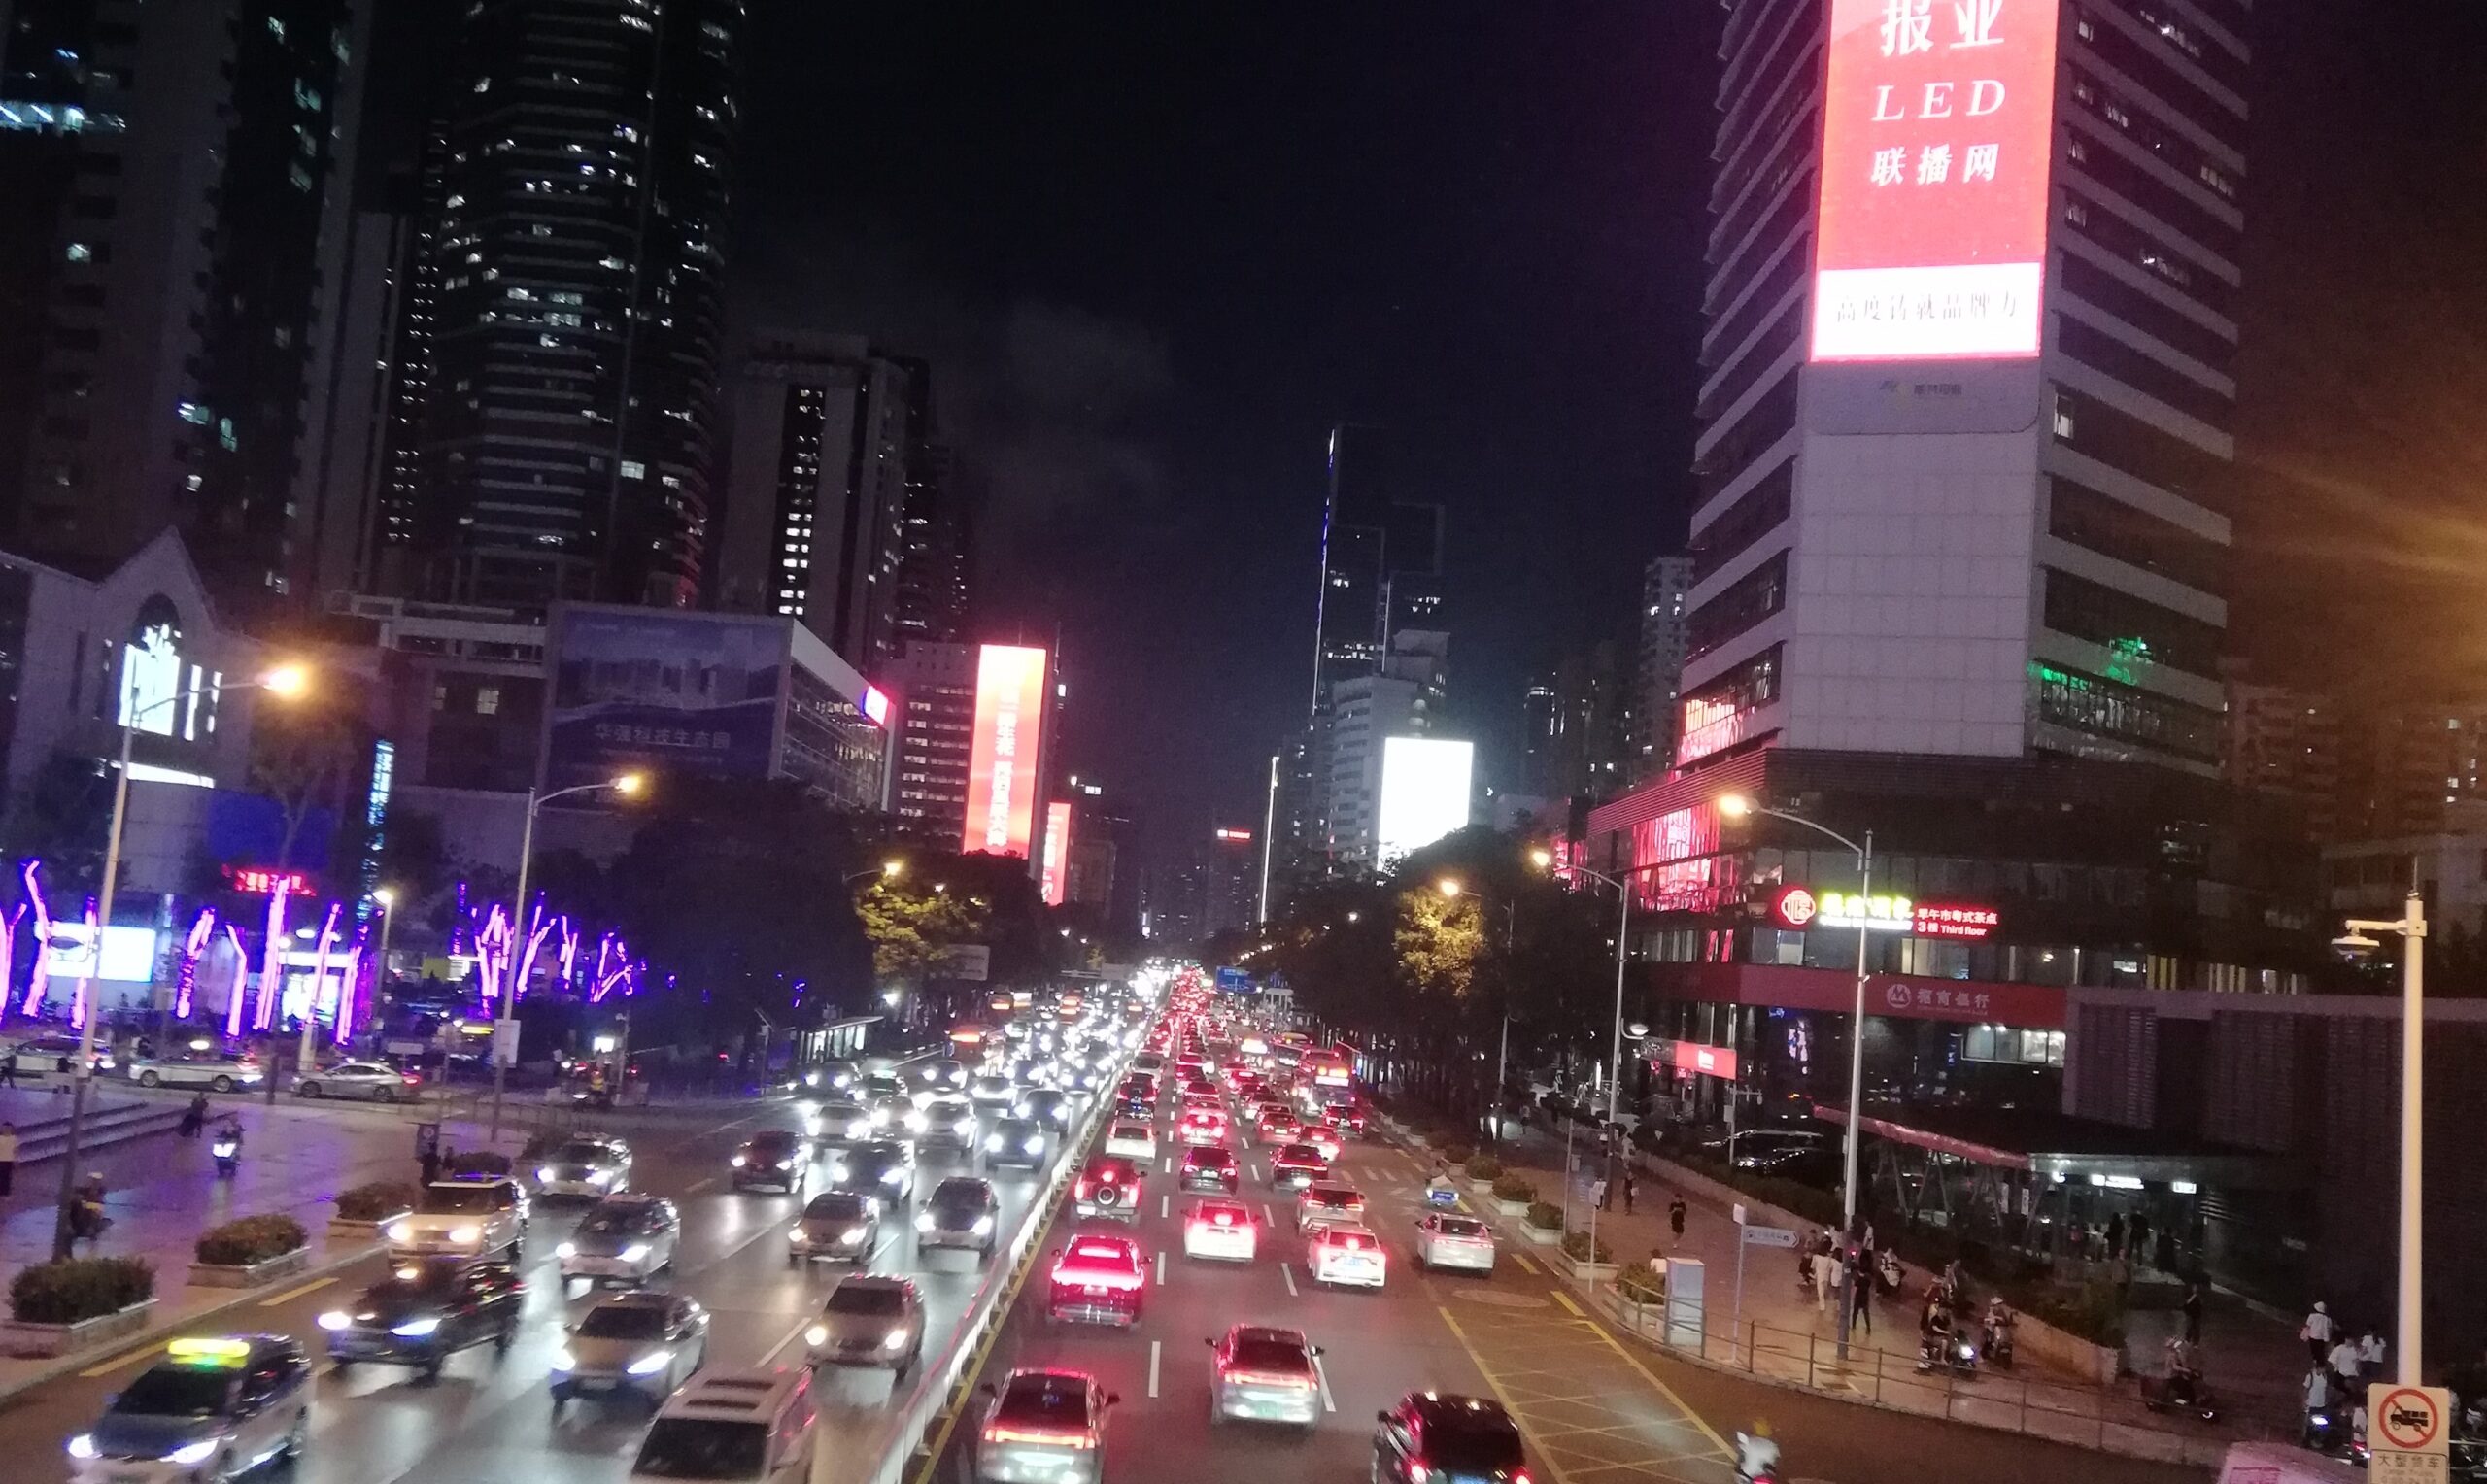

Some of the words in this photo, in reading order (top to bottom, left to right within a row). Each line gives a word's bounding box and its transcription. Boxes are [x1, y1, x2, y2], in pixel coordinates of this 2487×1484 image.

[1881, 0, 2005, 56] 报业
[1872, 79, 2006, 122] LED
[1871, 144, 2000, 187] 联播网
[1940, 925, 1963, 935] Third
[1965, 926, 1987, 936] floor
